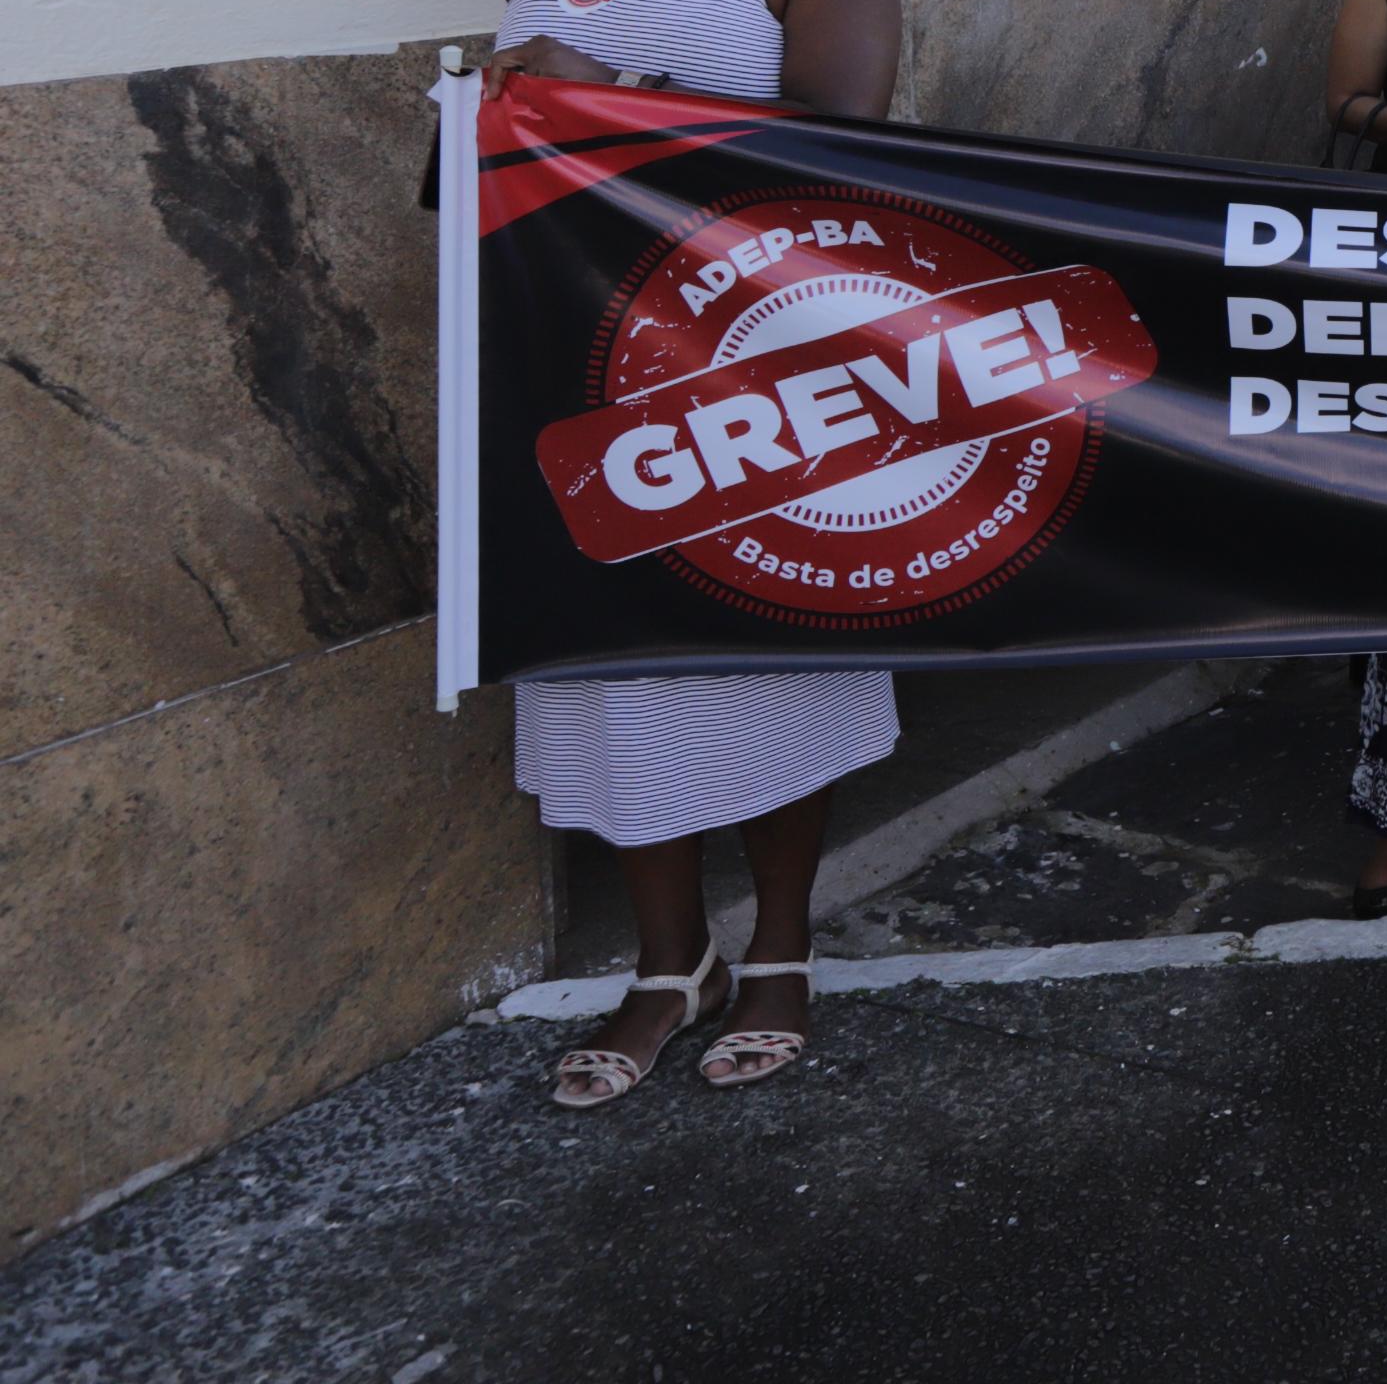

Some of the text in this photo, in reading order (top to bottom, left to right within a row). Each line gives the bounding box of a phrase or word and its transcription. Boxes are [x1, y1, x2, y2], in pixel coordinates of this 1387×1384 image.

[677, 218, 886, 318] ADEP-BA
[603, 298, 1082, 512] GREVE!
[732, 434, 1052, 591] Basta de desrespeito
